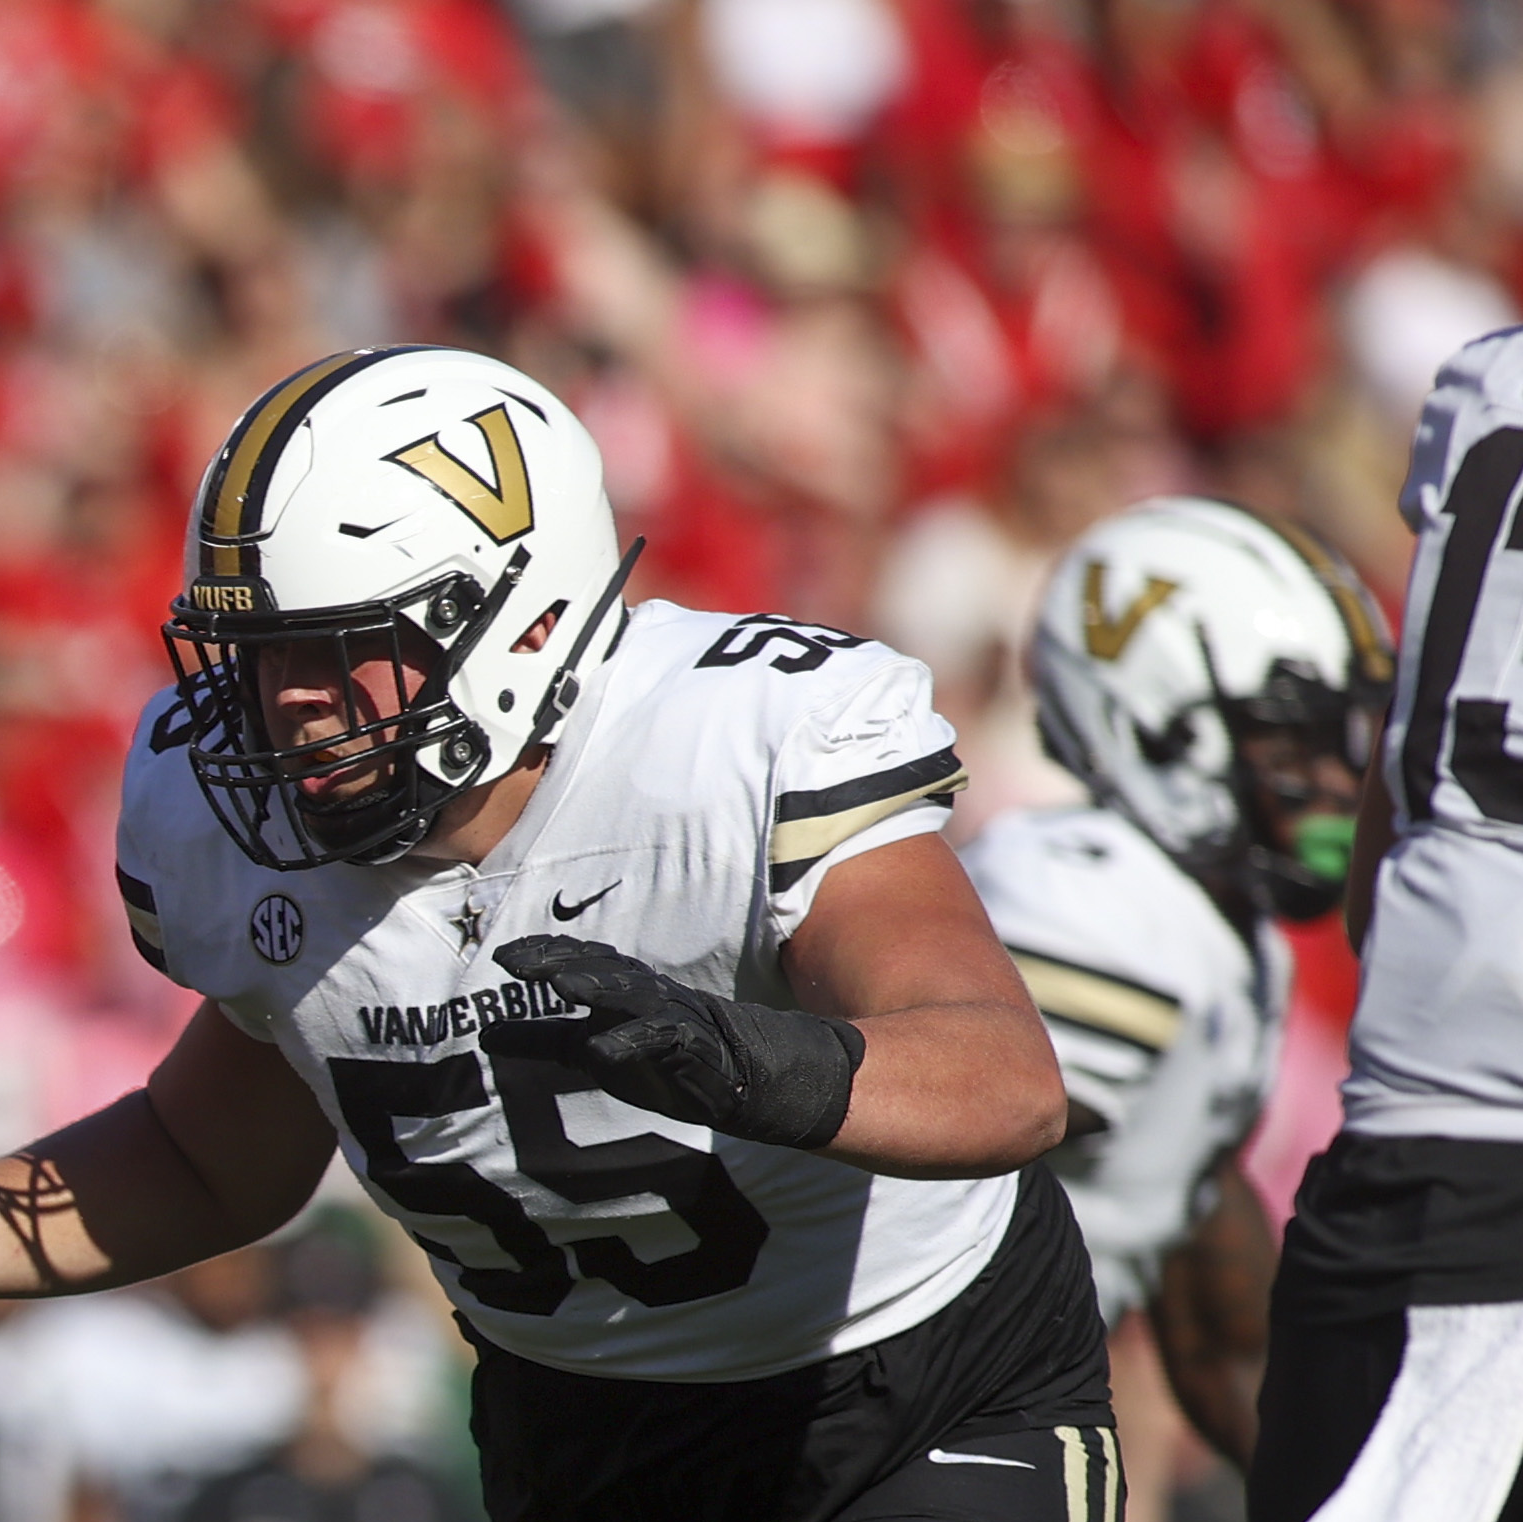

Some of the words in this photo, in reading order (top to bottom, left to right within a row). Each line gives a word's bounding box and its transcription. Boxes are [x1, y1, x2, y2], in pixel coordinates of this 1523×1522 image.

[381, 401, 534, 546] V
[193, 585, 253, 611] VUFB
[253, 896, 301, 960] SEC
[327, 1050, 770, 1316] 55
